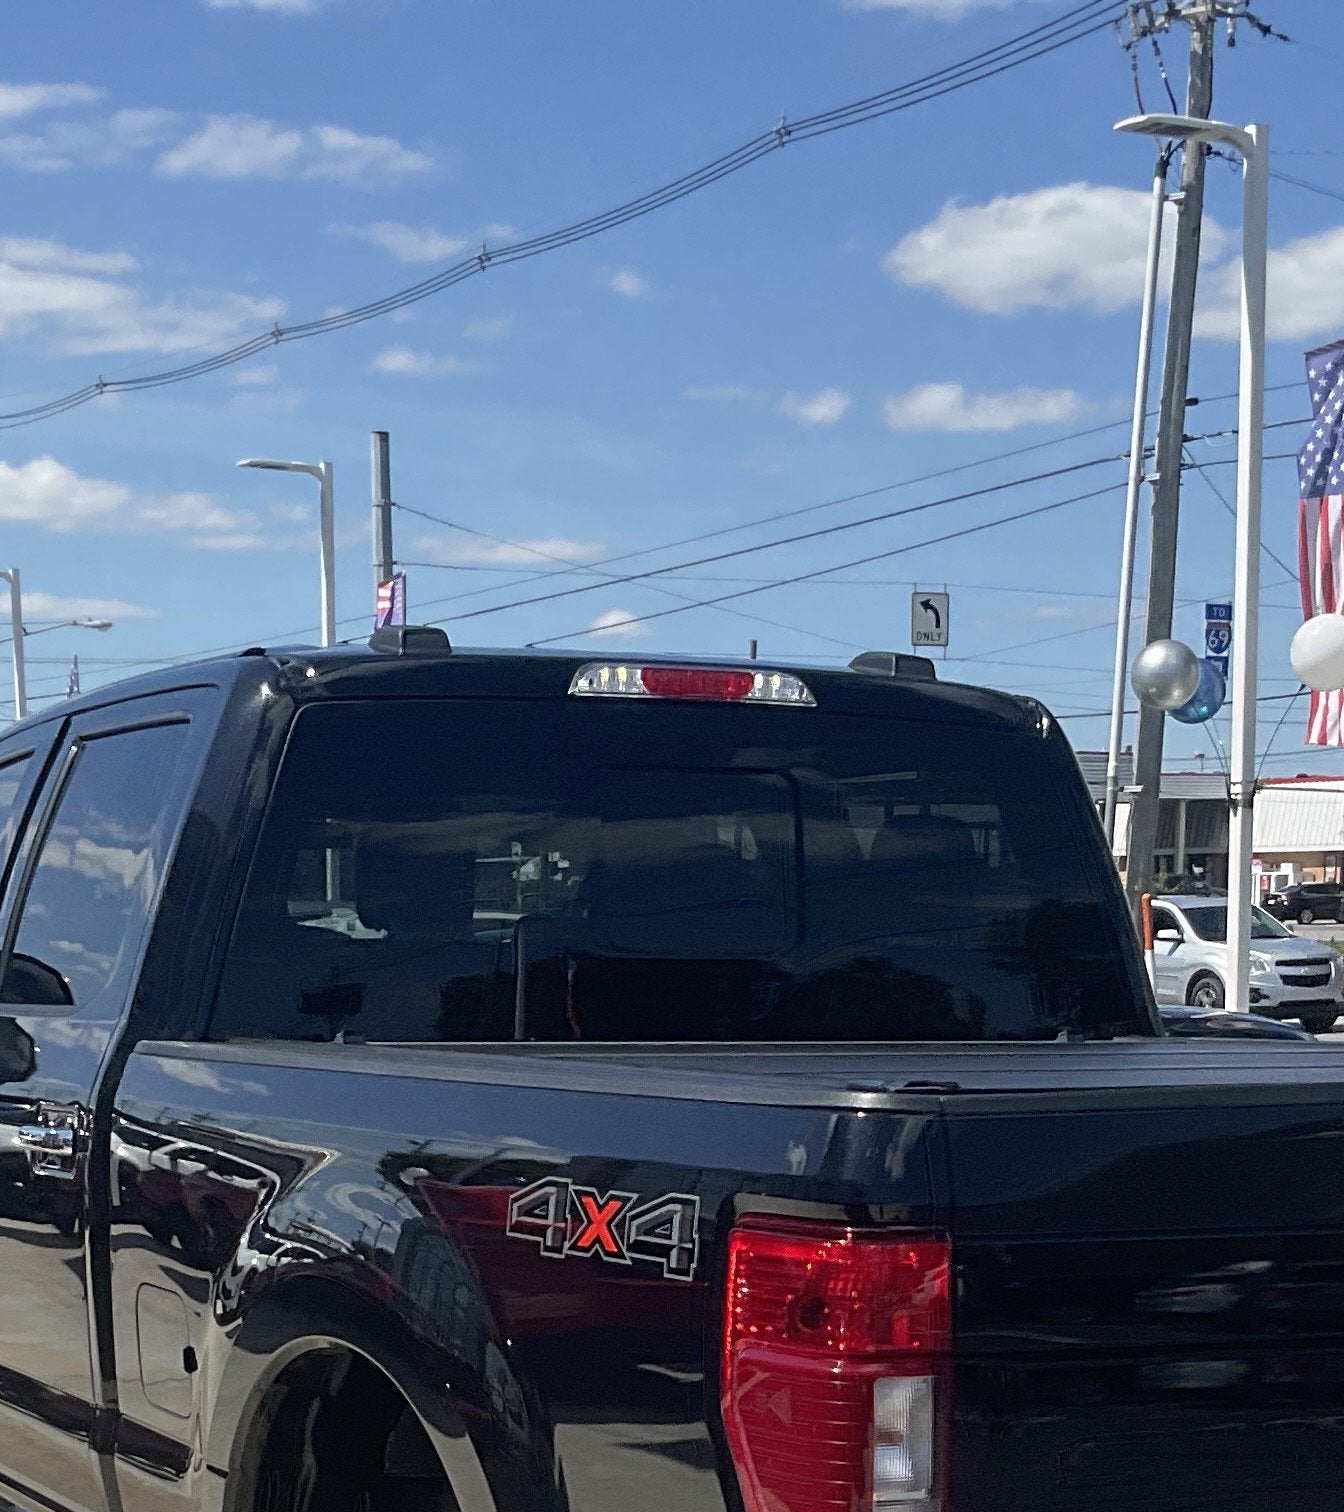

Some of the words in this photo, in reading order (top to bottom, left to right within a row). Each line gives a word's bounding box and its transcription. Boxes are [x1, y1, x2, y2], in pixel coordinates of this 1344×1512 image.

[1212, 606, 1226, 617] TO
[916, 631, 944, 642] ONLY
[1208, 628, 1229, 649] 69
